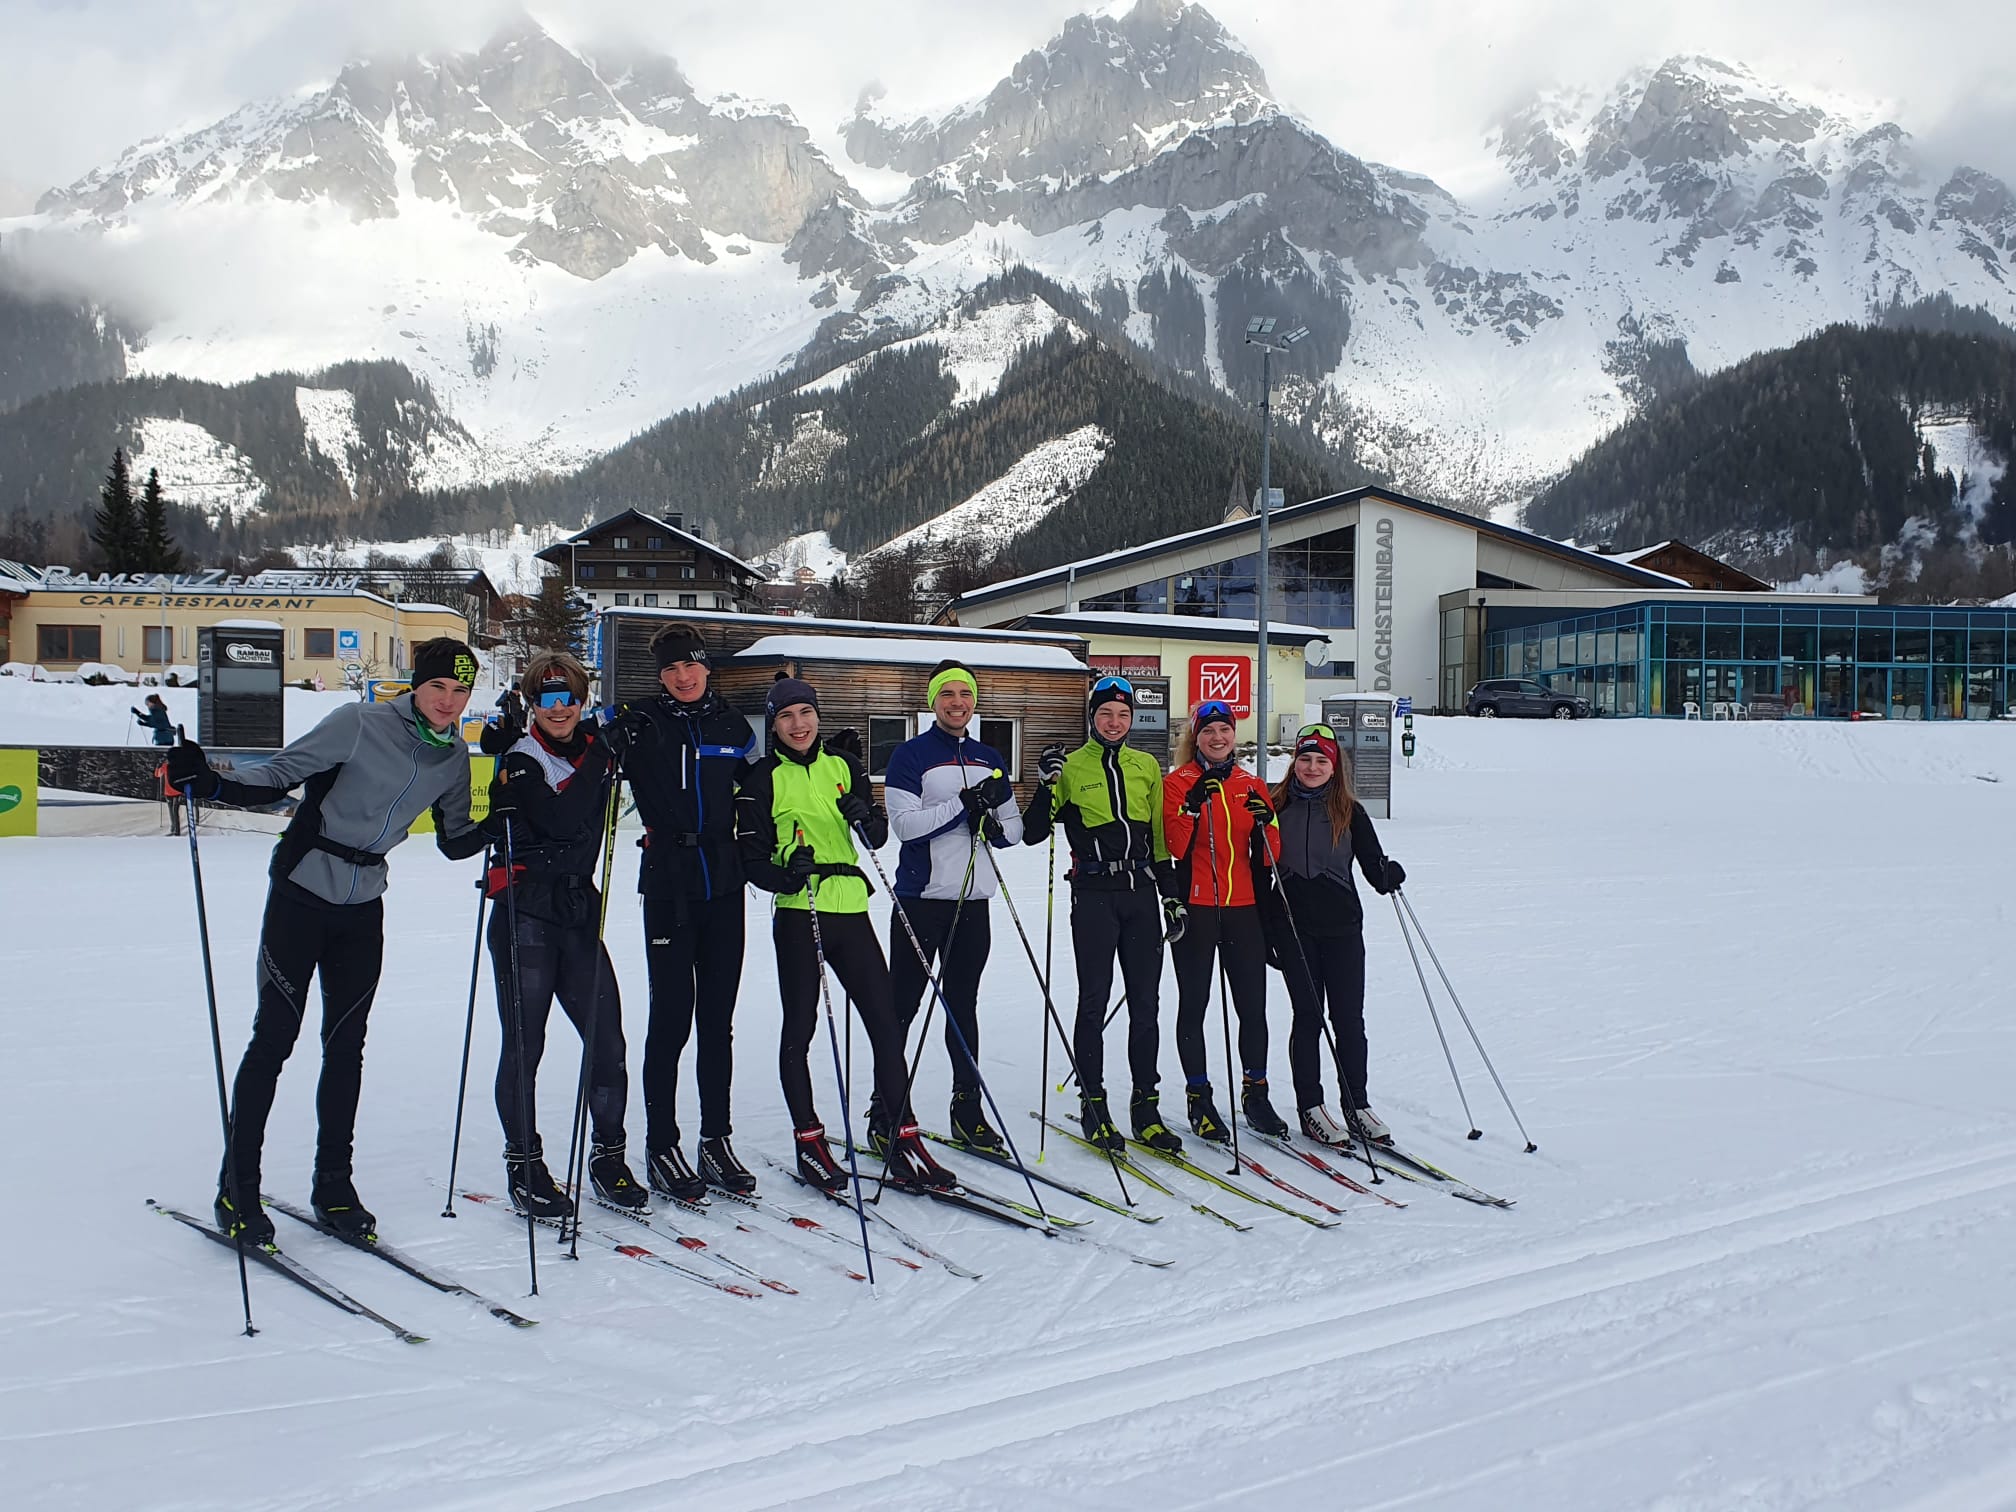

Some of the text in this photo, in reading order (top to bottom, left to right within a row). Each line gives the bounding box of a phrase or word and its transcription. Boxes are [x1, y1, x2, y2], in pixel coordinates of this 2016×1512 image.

[80, 595, 316, 609] CAFE-RESTAURANT
[1374, 518, 1394, 691] DACHSTEINBAD
[1139, 715, 1157, 723] ZIEL
[709, 1189, 759, 1209] ADSHUS
[597, 1201, 651, 1226] MADSHUS
